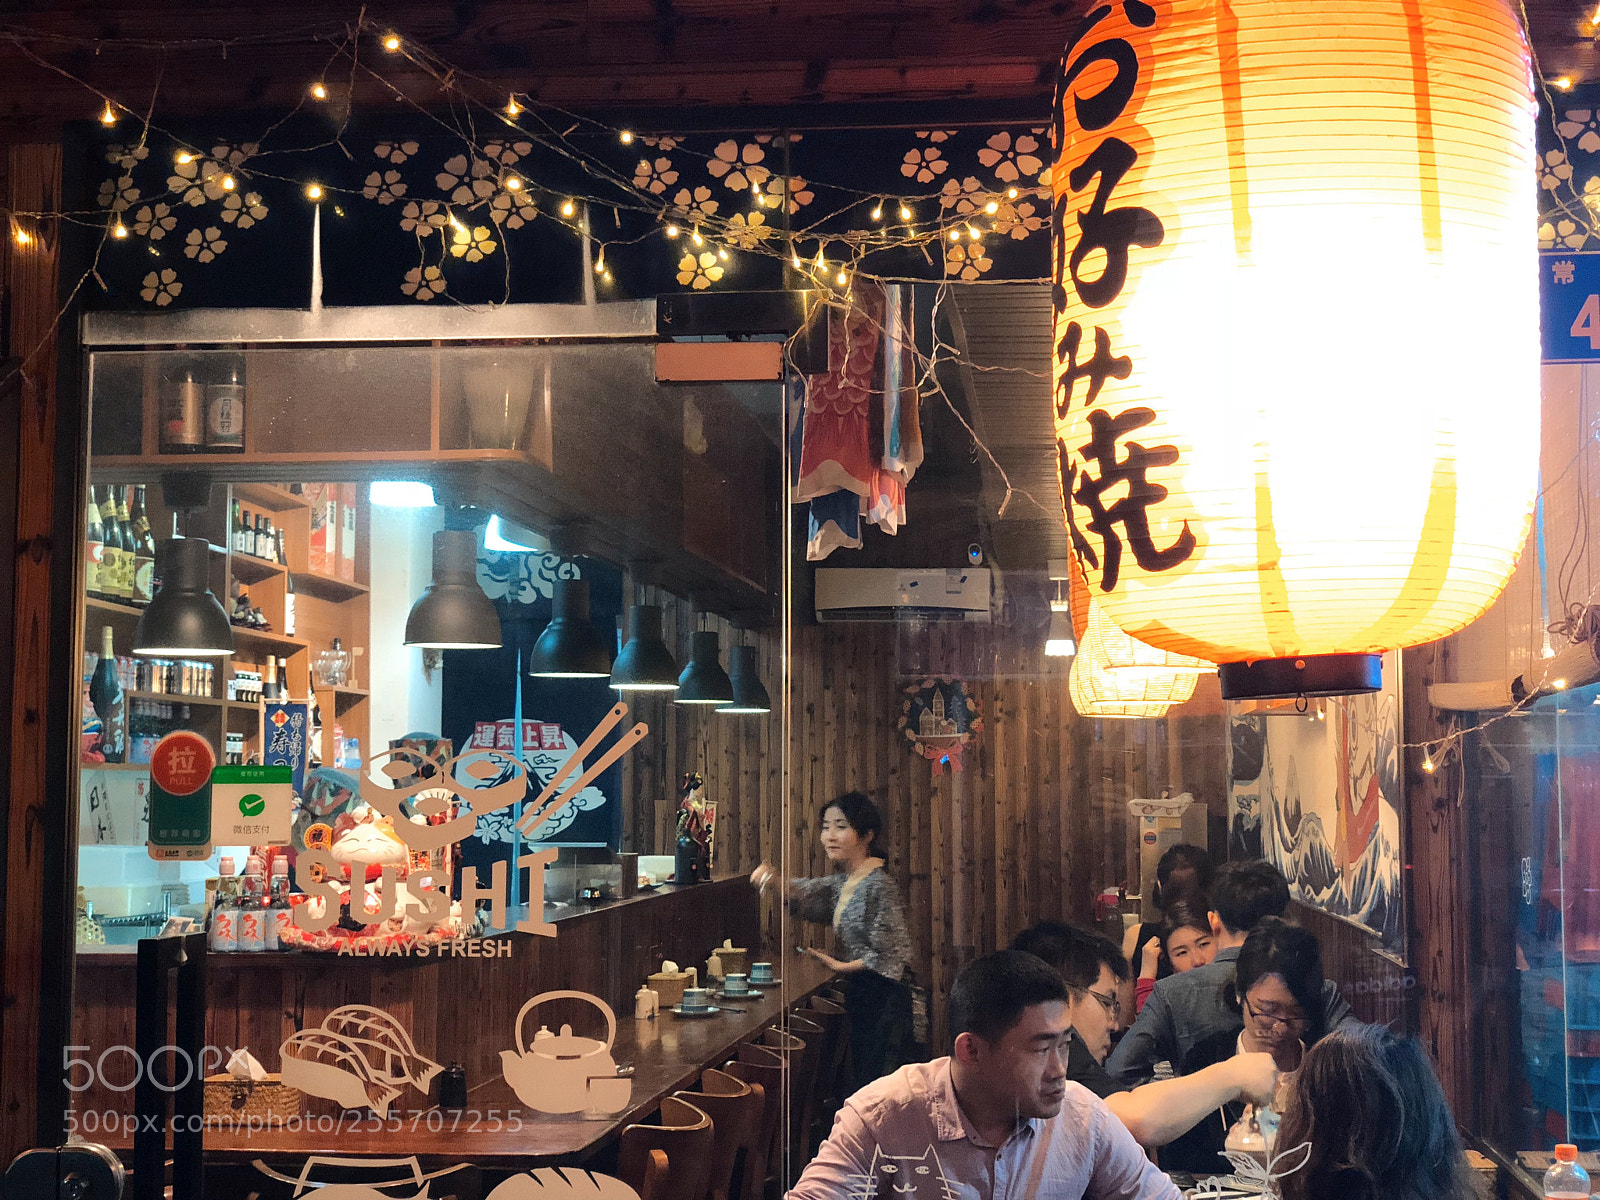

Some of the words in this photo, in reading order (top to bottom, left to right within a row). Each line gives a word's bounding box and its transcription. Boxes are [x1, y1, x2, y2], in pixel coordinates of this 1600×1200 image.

[1570, 294, 1600, 350] 4
[168, 746, 197, 775] 拉
[169, 776, 192, 786] PULL
[233, 824, 270, 835] 微信支付
[294, 846, 559, 938] SUSHI
[337, 939, 431, 958] ALWAYS
[437, 940, 512, 959] FRESH
